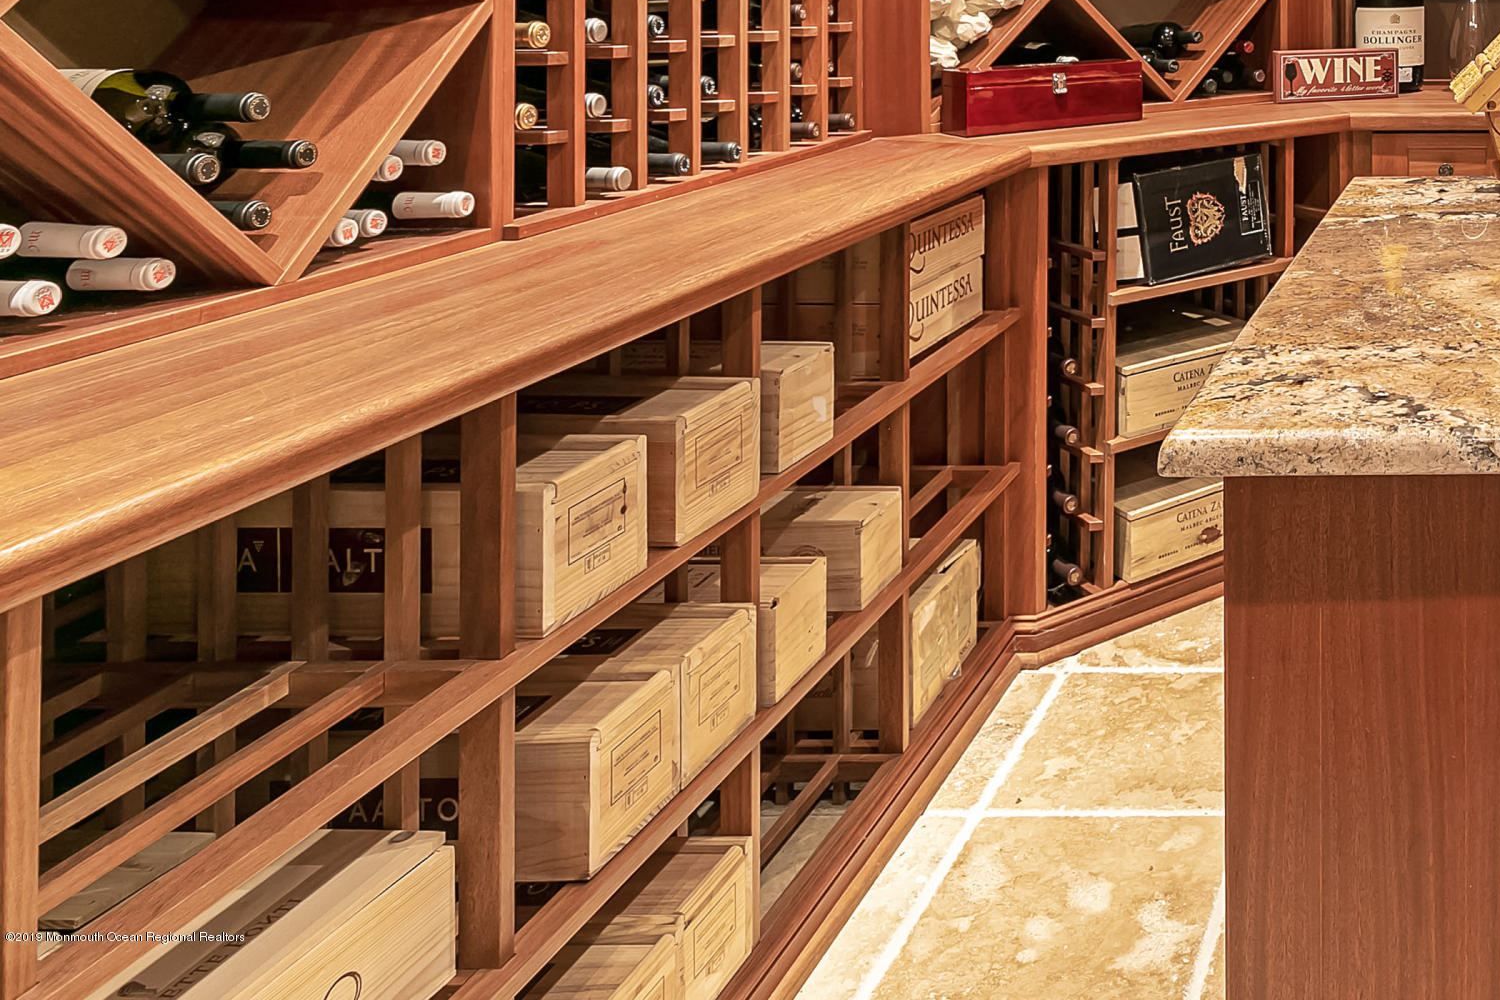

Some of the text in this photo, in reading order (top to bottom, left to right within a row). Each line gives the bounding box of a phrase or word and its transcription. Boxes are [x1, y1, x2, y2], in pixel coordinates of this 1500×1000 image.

[1363, 35, 1423, 45] BOLLINGER
[1297, 56, 1382, 85] WINE
[1240, 194, 1249, 221] FAUST
[1164, 196, 1189, 254] FAUST
[1173, 367, 1205, 383] CATENA
[1176, 507, 1208, 523] CATENA
